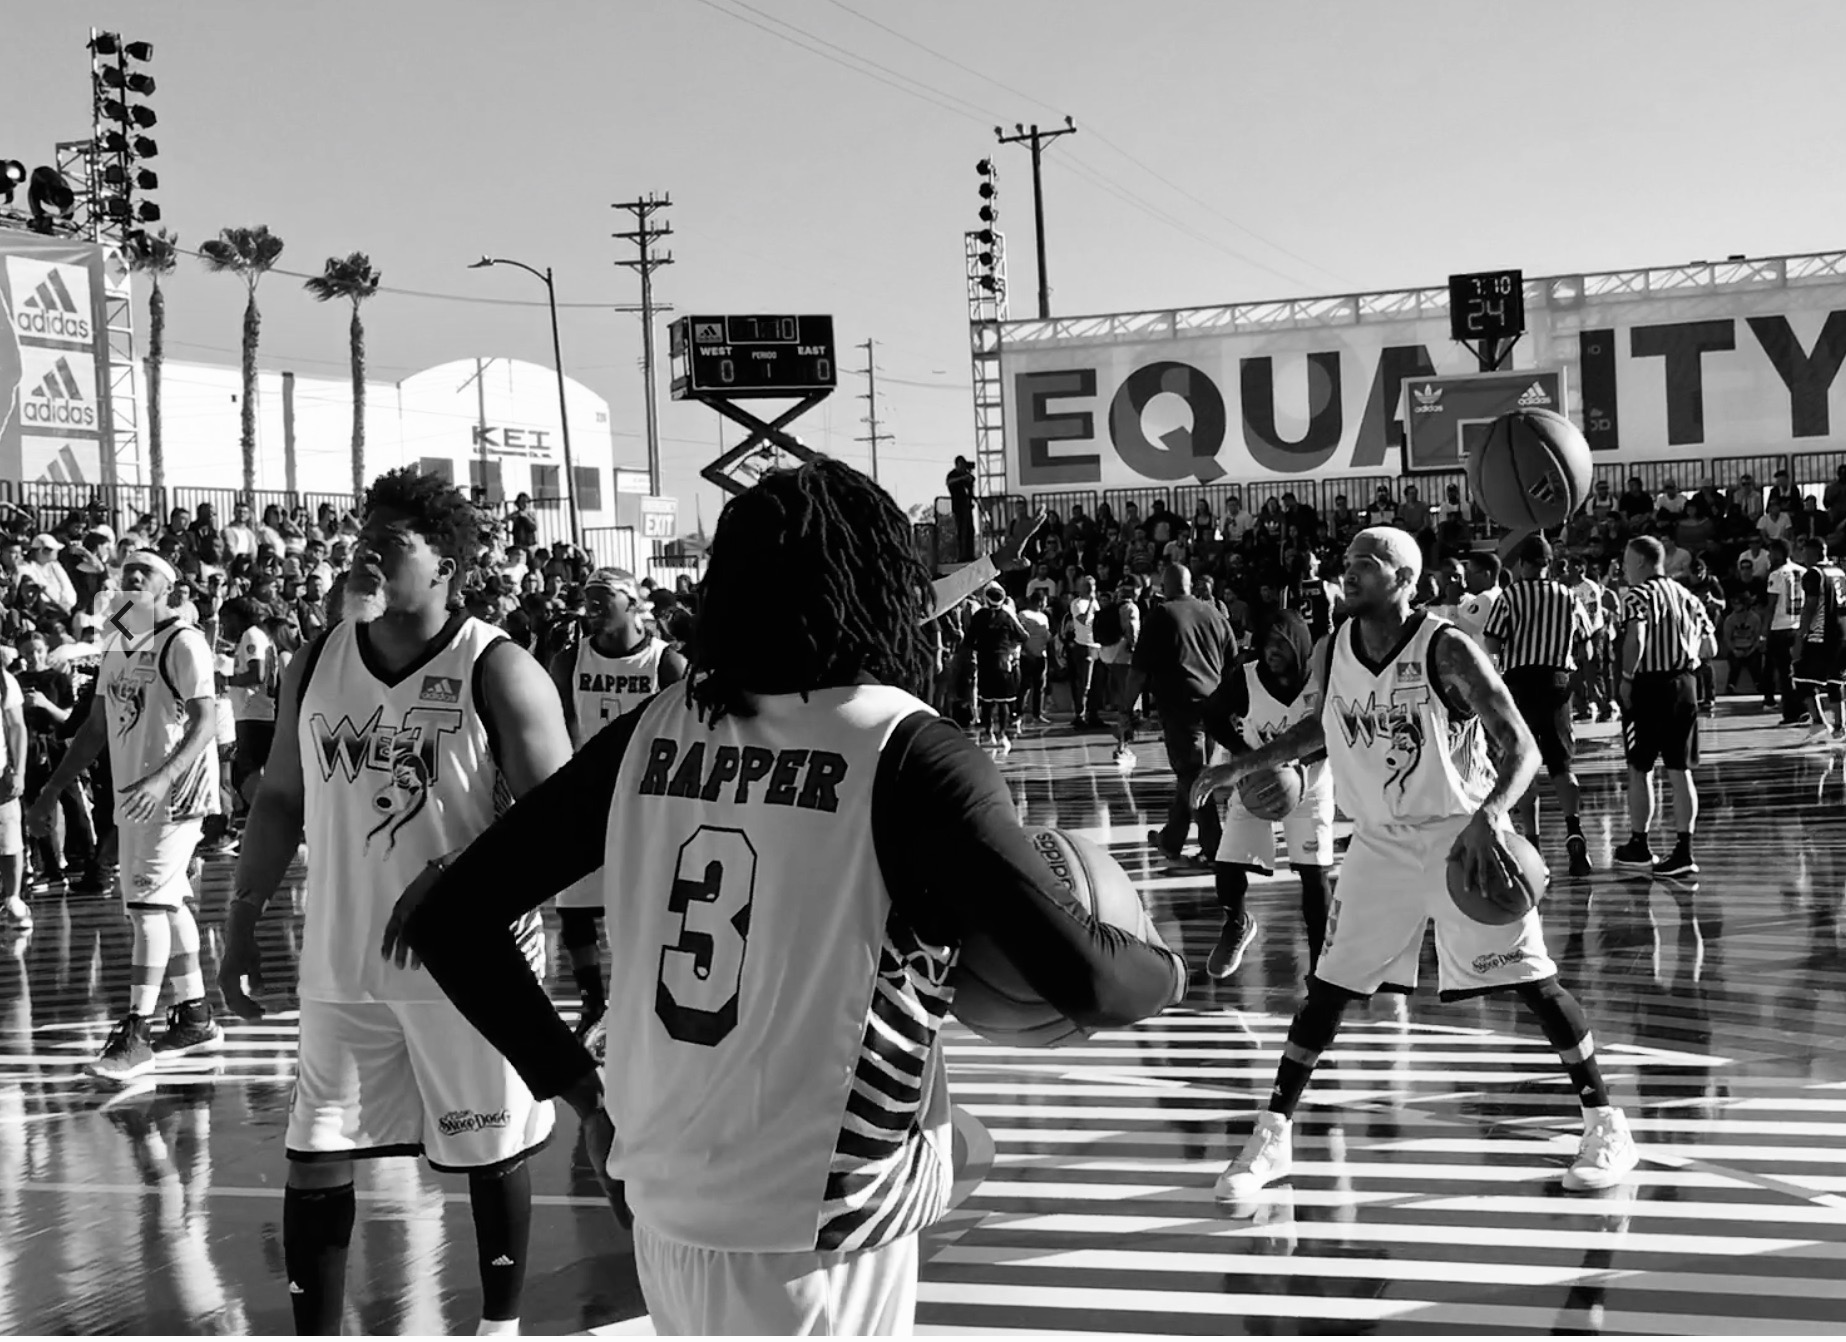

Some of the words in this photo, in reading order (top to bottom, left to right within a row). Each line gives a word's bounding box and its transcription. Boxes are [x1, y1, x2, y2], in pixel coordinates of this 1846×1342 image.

[1472, 276, 1511, 295] 7:10
[17, 309, 89, 339] adidas
[1468, 299, 1505, 331] 24
[700, 346, 733, 356] WEST
[797, 346, 826, 356] EAST
[720, 359, 735, 383] 0
[817, 358, 830, 381] 0
[23, 401, 95, 425] adidas
[1413, 404, 1444, 414] adidas
[471, 425, 551, 450] KEI
[579, 673, 652, 694] RAPPER
[638, 737, 849, 814] RAPPER
[655, 824, 758, 1047] 3
